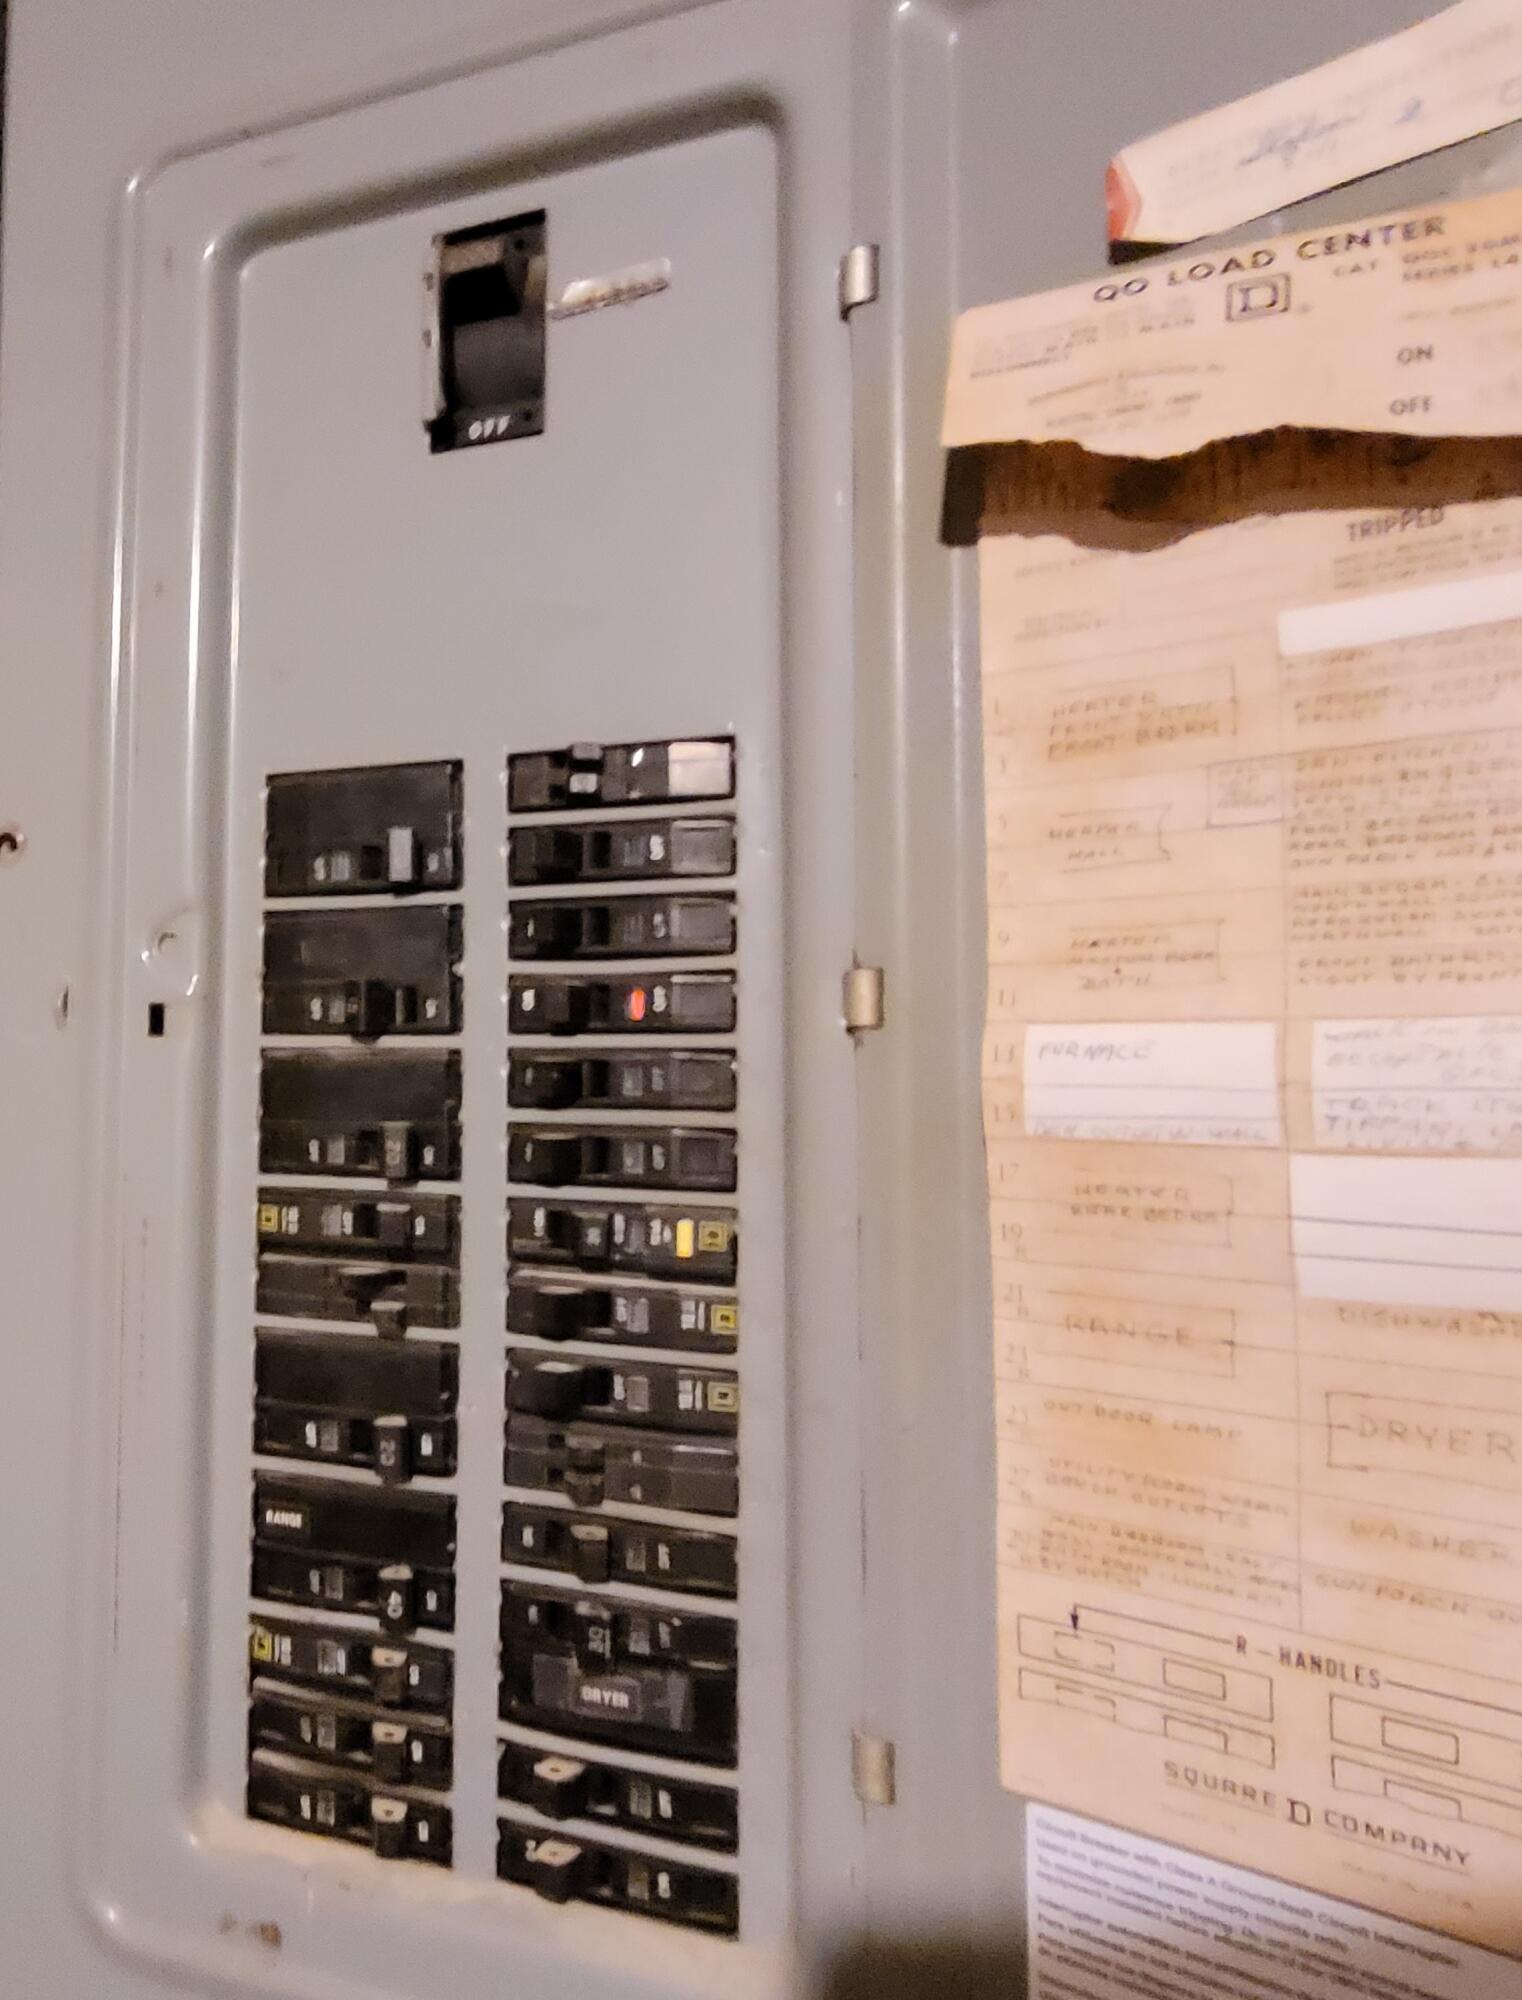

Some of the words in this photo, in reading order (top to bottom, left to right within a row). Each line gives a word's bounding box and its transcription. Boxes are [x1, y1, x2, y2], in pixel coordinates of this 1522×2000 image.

[1167, 247, 1277, 287] LOAD
[1297, 215, 1447, 261] CENTER
[1396, 343, 1434, 366] ON
[1388, 395, 1433, 417] OFF
[469, 415, 510, 440] OFF
[1345, 507, 1446, 543] TRIPPED
[1039, 1038, 1158, 1062] FURNACE
[1065, 1313, 1197, 1346] RANGE
[1357, 1412, 1517, 1464] DRYER
[1236, 1634, 1249, 1657] R
[1278, 1645, 1382, 1691] HANDLES
[580, 1684, 630, 1709] DRYER
[1163, 1759, 1277, 1809] SQUARE
[1286, 1796, 1313, 1828] D
[1323, 1808, 1473, 1868] COMPANY
